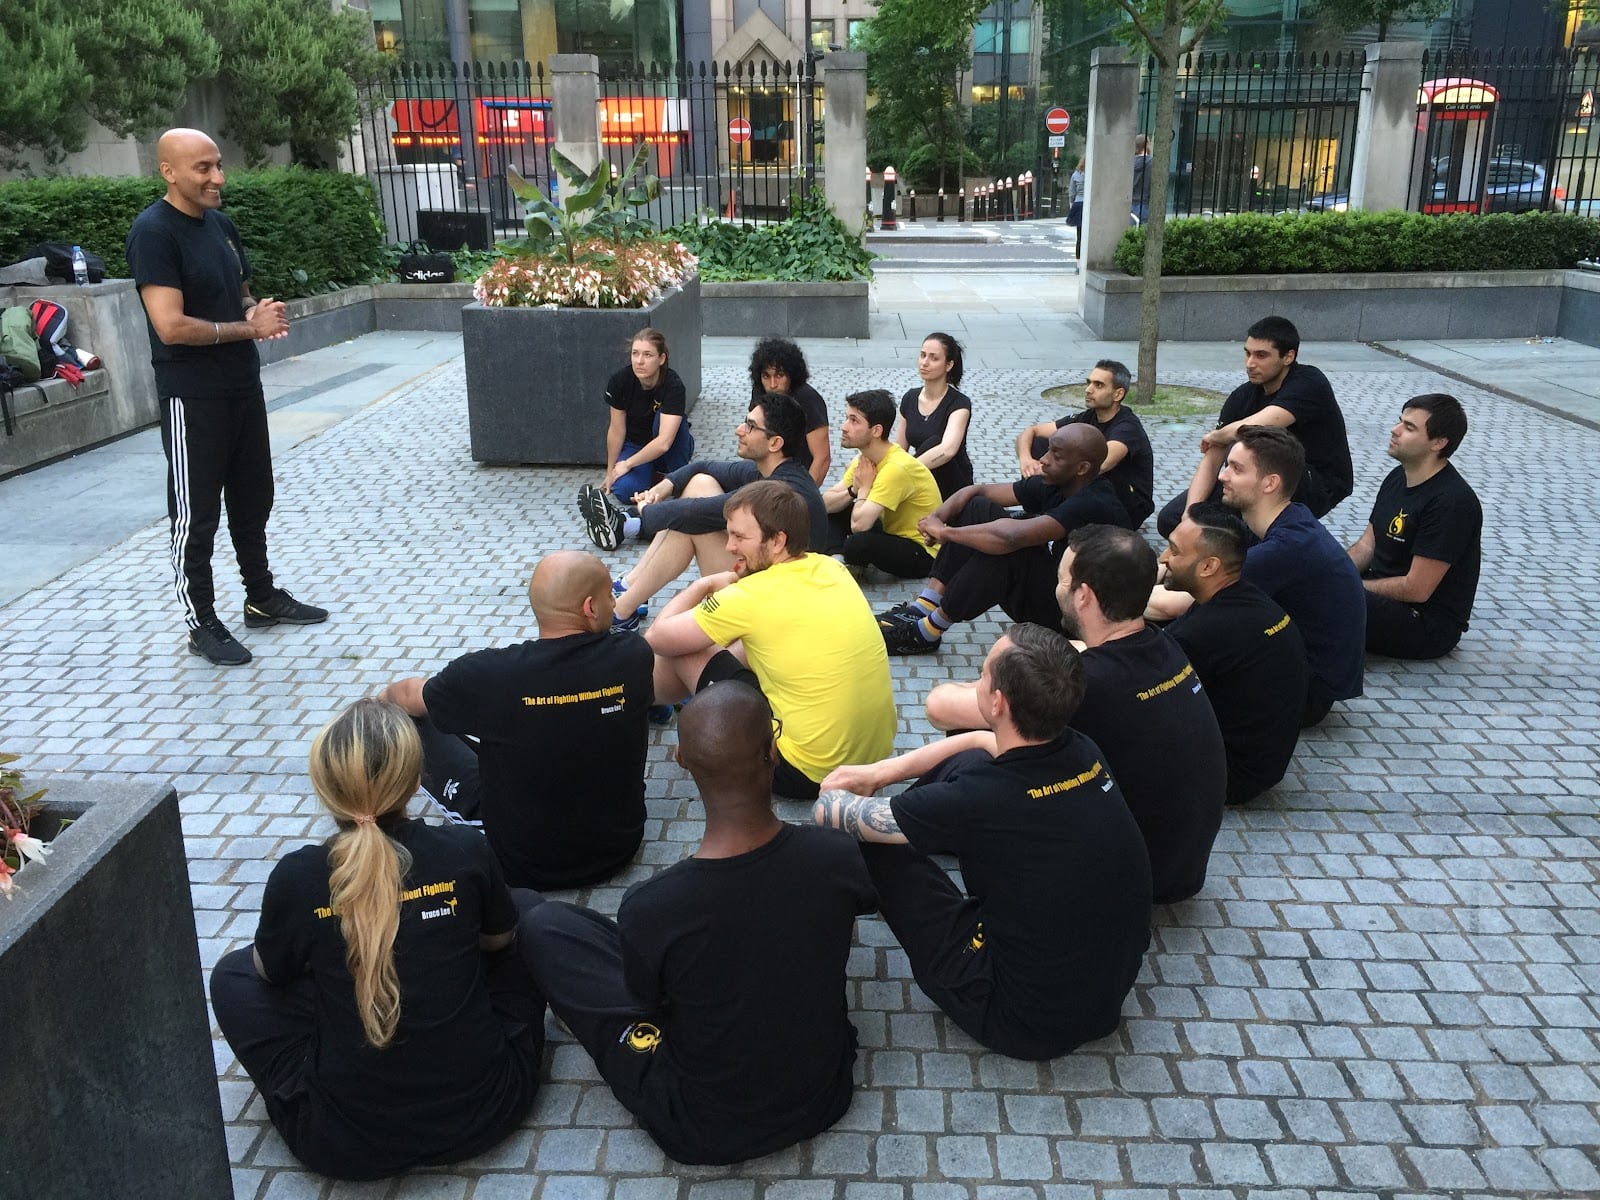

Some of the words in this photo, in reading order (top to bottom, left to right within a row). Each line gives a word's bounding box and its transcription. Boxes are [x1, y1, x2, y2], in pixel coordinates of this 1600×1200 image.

[536, 696, 546, 705] Art
[547, 696, 553, 705] of
[554, 694, 579, 705] Fighting
[579, 690, 602, 701] Without
[421, 909, 441, 920] Bruce
[440, 907, 451, 916] Lee
